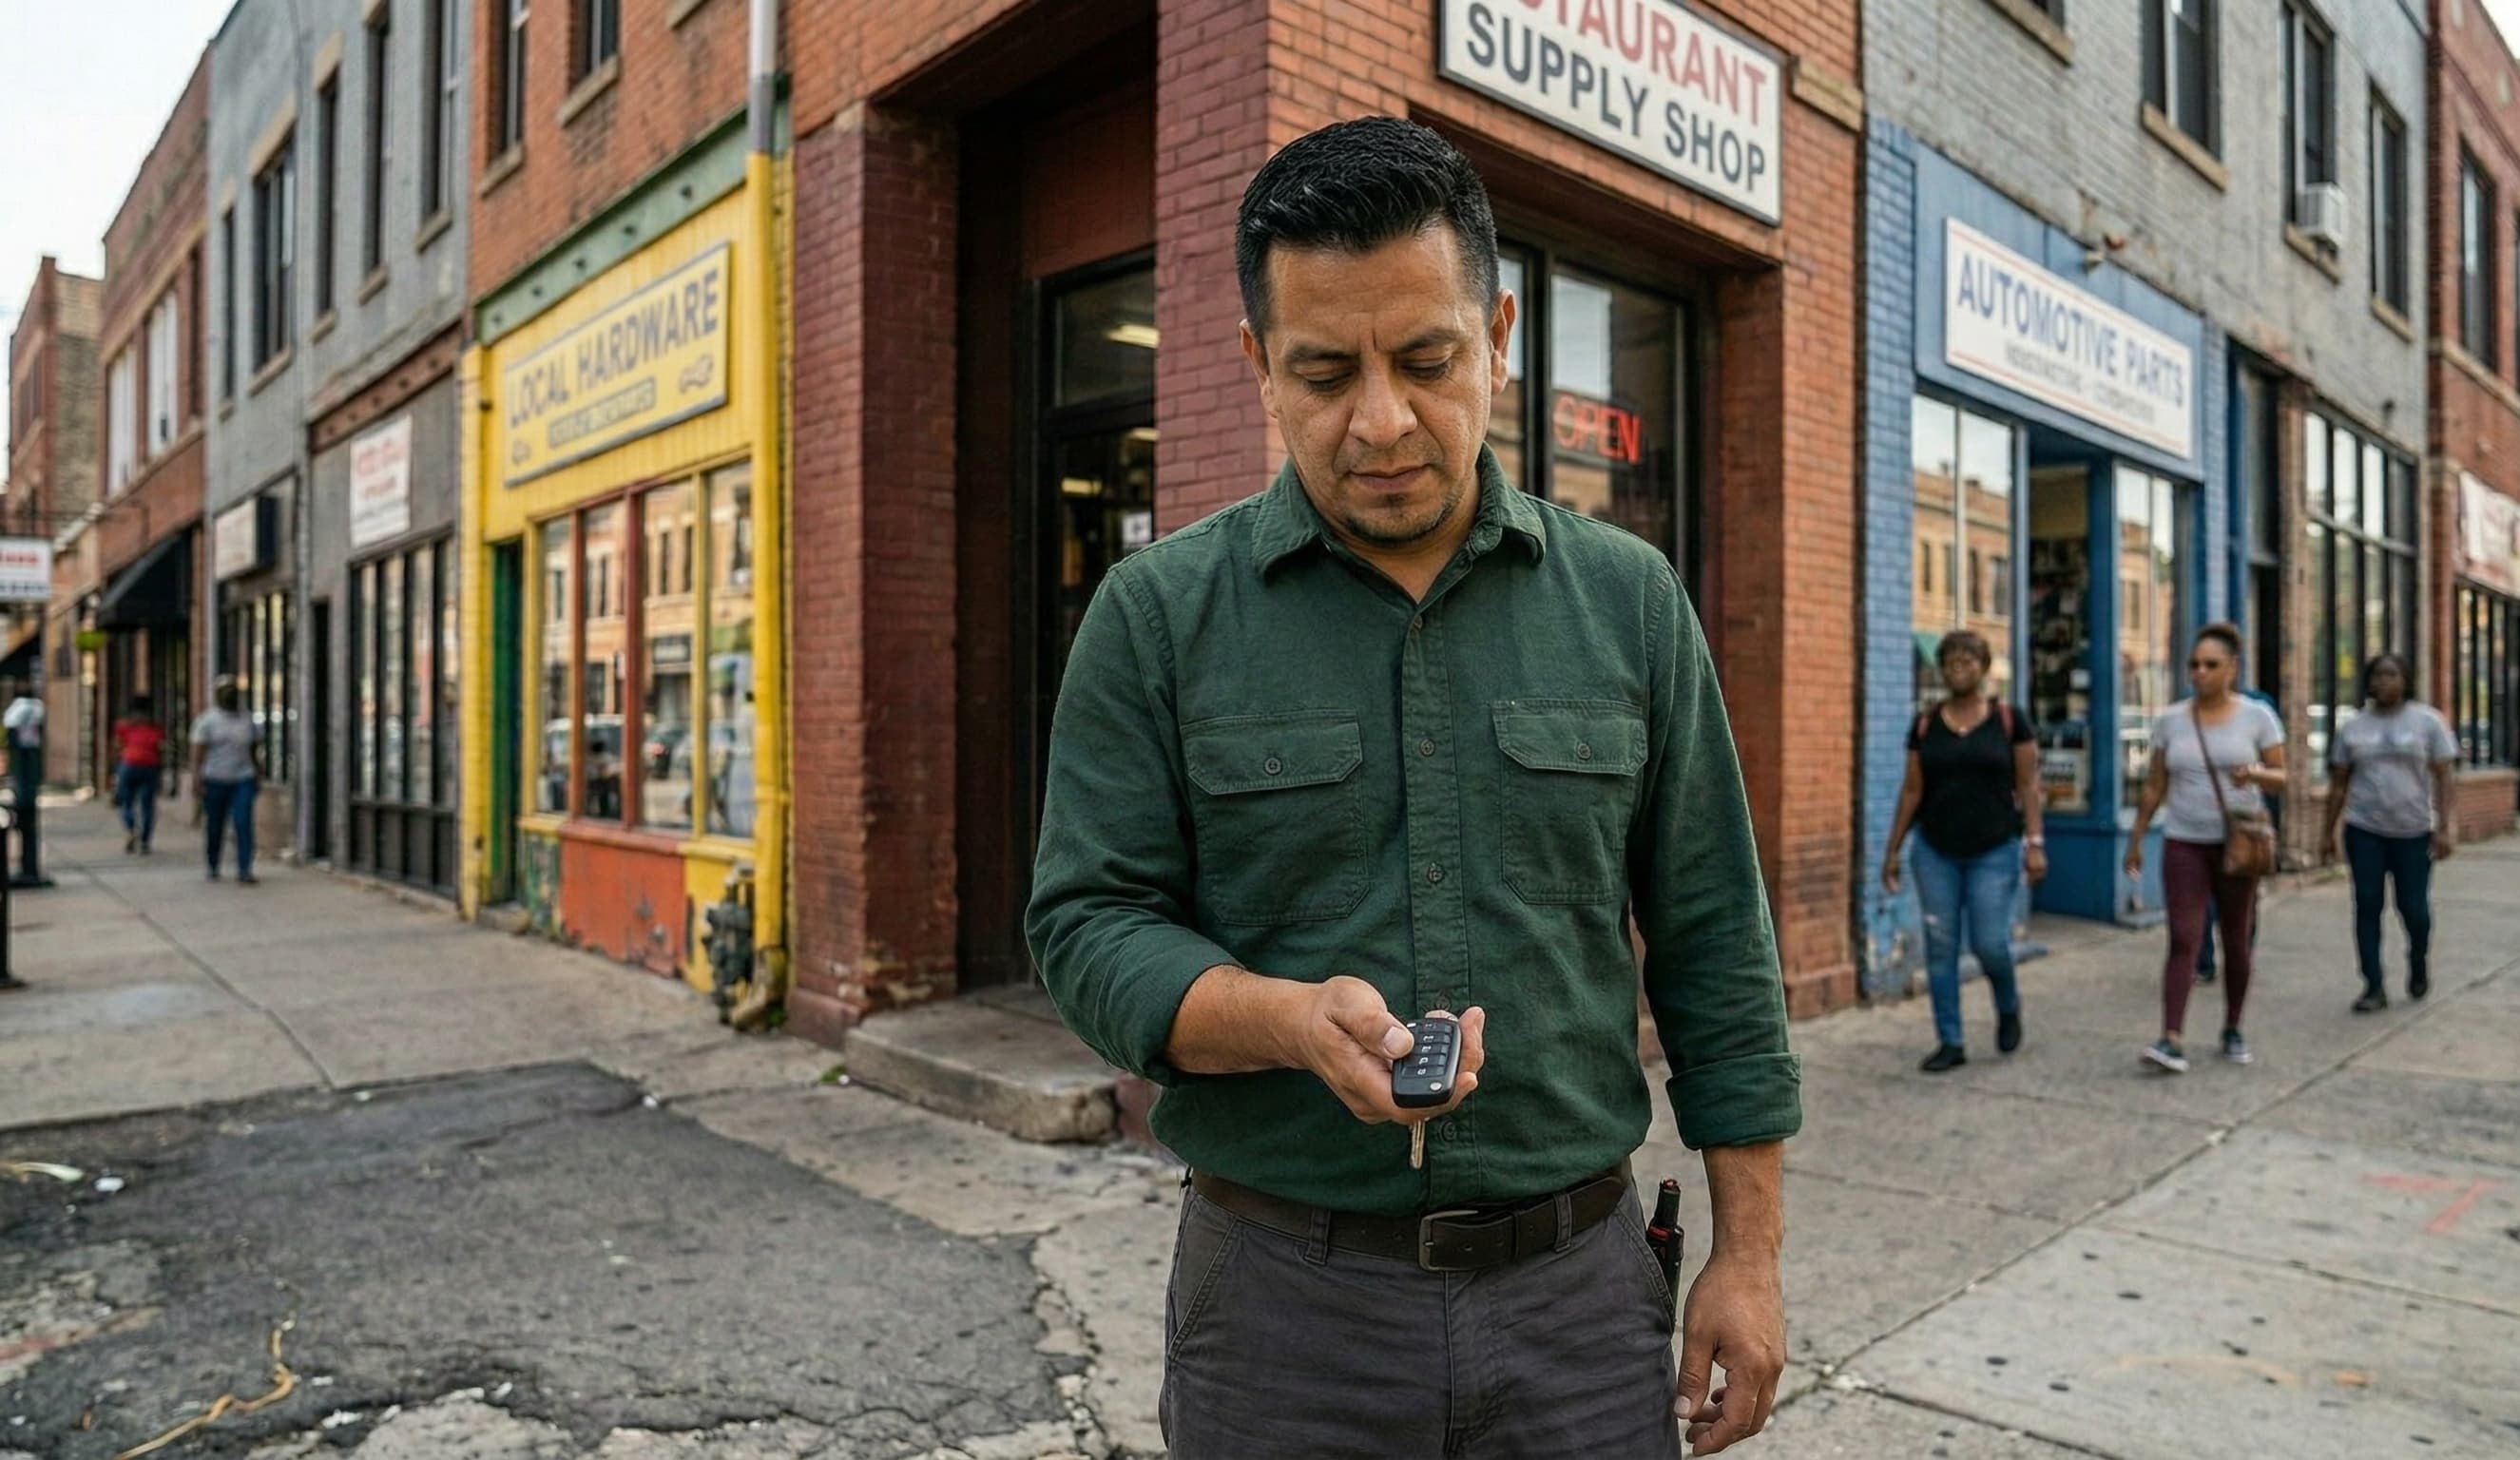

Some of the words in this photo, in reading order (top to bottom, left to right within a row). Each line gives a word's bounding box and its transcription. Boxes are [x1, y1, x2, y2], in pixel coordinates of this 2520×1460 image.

[1467, 2, 1649, 138] SUPPLY
[1665, 101, 1765, 191] SHOP
[1519, 0, 1766, 125] AURANT
[510, 353, 568, 428] LOCAL
[578, 269, 718, 395] HARDWARE
[1958, 253, 2118, 377] AUTOMOTIVE
[2125, 337, 2183, 409] PARTS
[1552, 392, 1640, 465] OPEN
